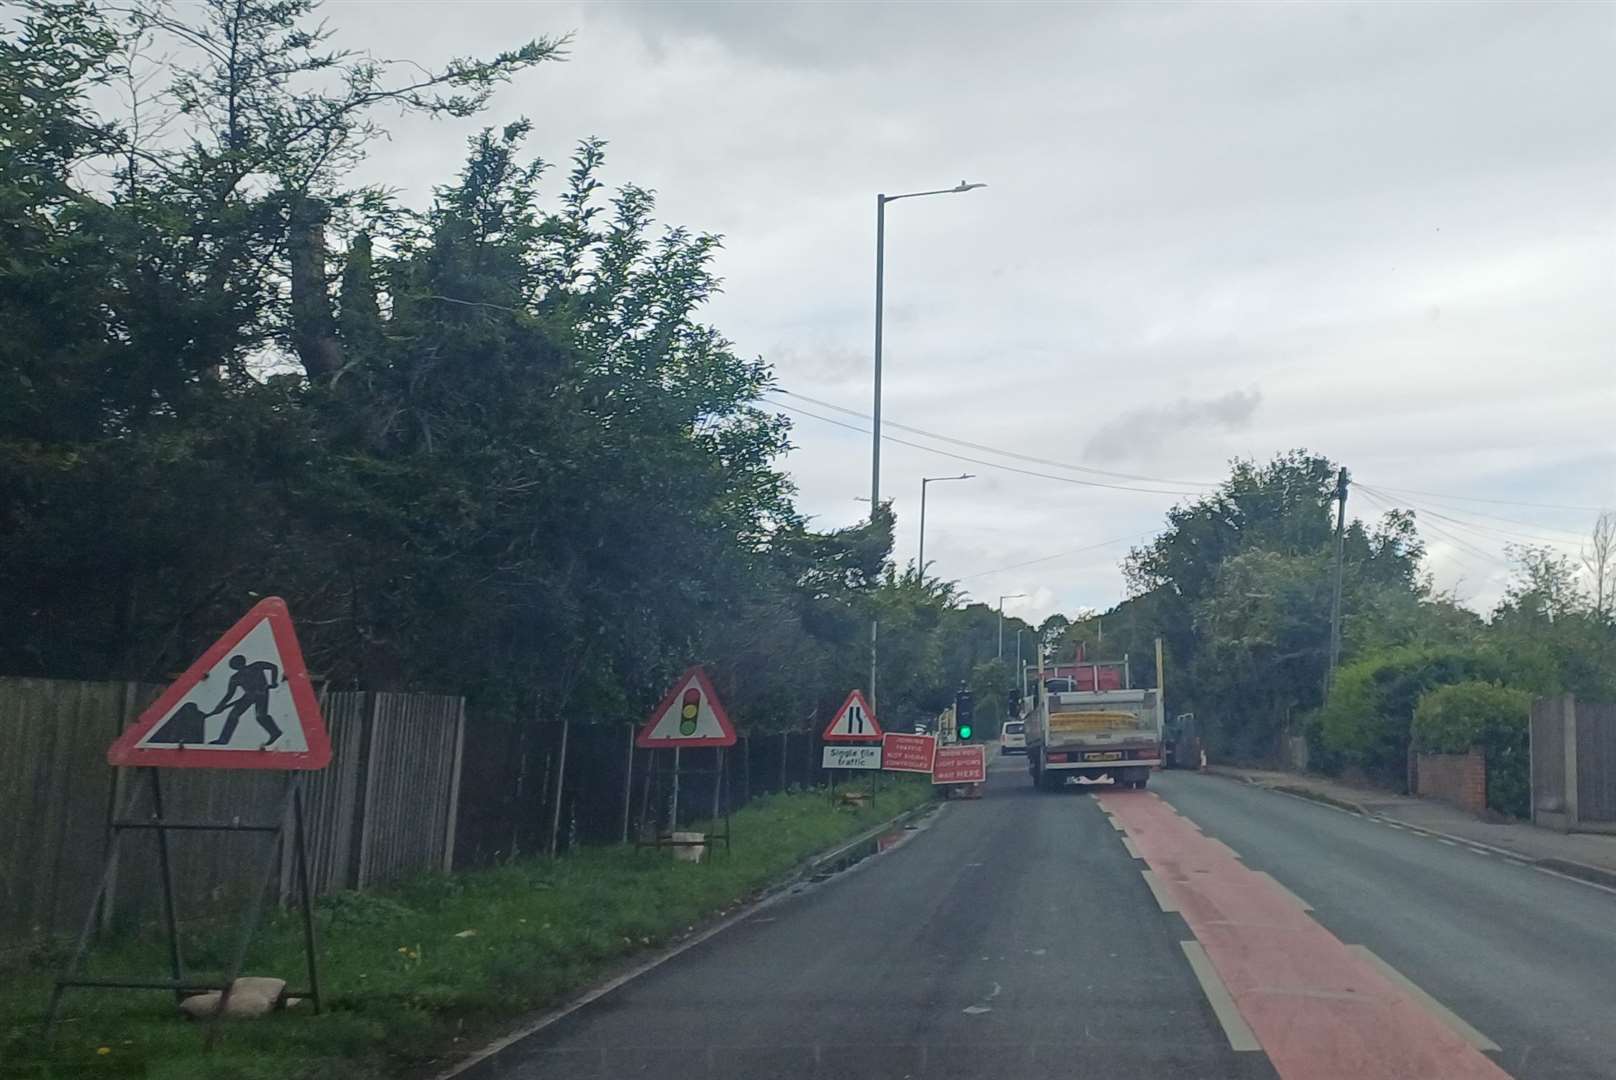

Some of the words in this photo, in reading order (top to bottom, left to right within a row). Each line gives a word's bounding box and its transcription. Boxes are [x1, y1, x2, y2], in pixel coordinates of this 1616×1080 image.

[830, 749, 857, 759] Single
[860, 749, 875, 758] file
[838, 758, 865, 766] traffic
